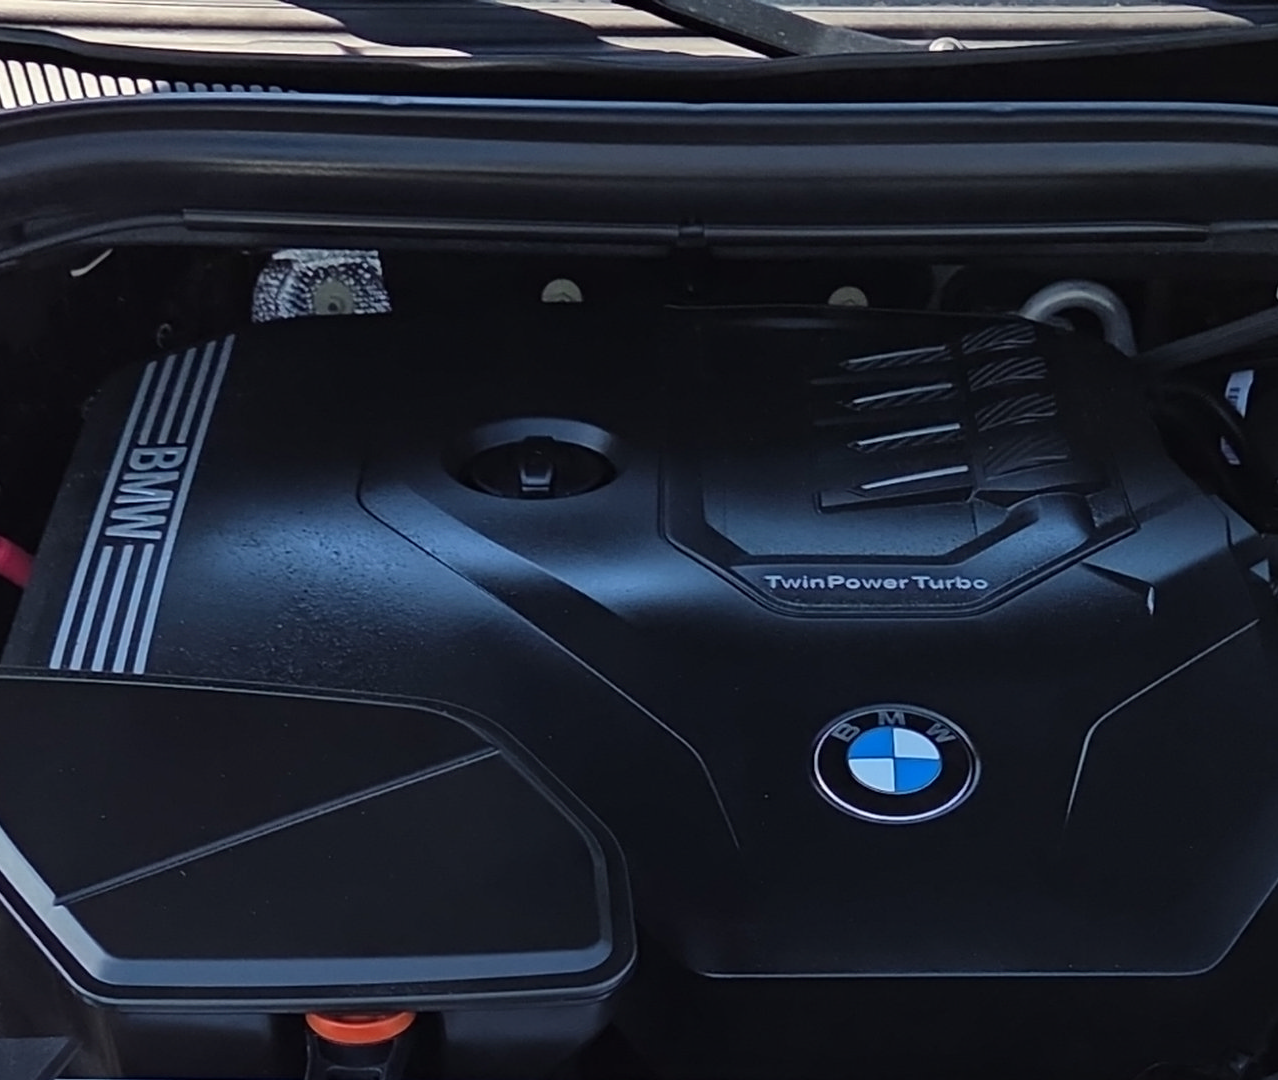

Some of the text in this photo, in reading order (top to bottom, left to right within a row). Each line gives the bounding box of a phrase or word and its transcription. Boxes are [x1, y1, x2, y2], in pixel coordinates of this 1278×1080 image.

[104, 447, 188, 540] BMW
[764, 575, 989, 590] TwinPower Turbo
[831, 711, 957, 743] BMW
